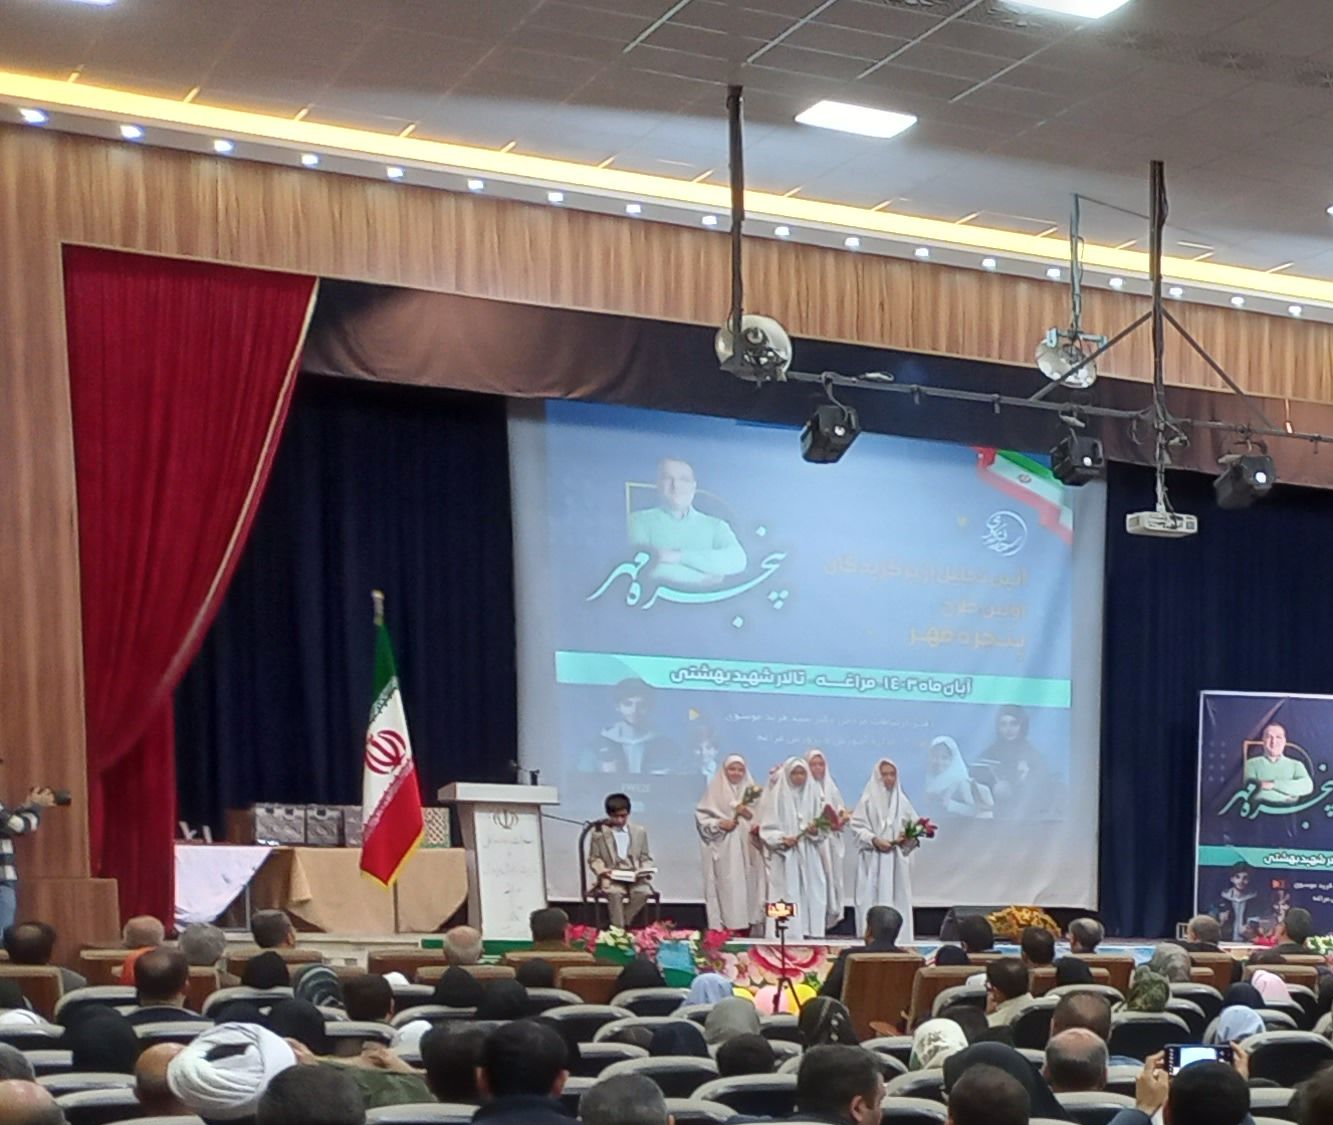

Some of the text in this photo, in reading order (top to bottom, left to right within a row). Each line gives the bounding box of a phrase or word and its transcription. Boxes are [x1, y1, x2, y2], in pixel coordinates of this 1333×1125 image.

[671, 663, 731, 686] بهشتی
[732, 667, 775, 688] شهید
[776, 670, 806, 688] تالار
[918, 678, 942, 692] ماه
